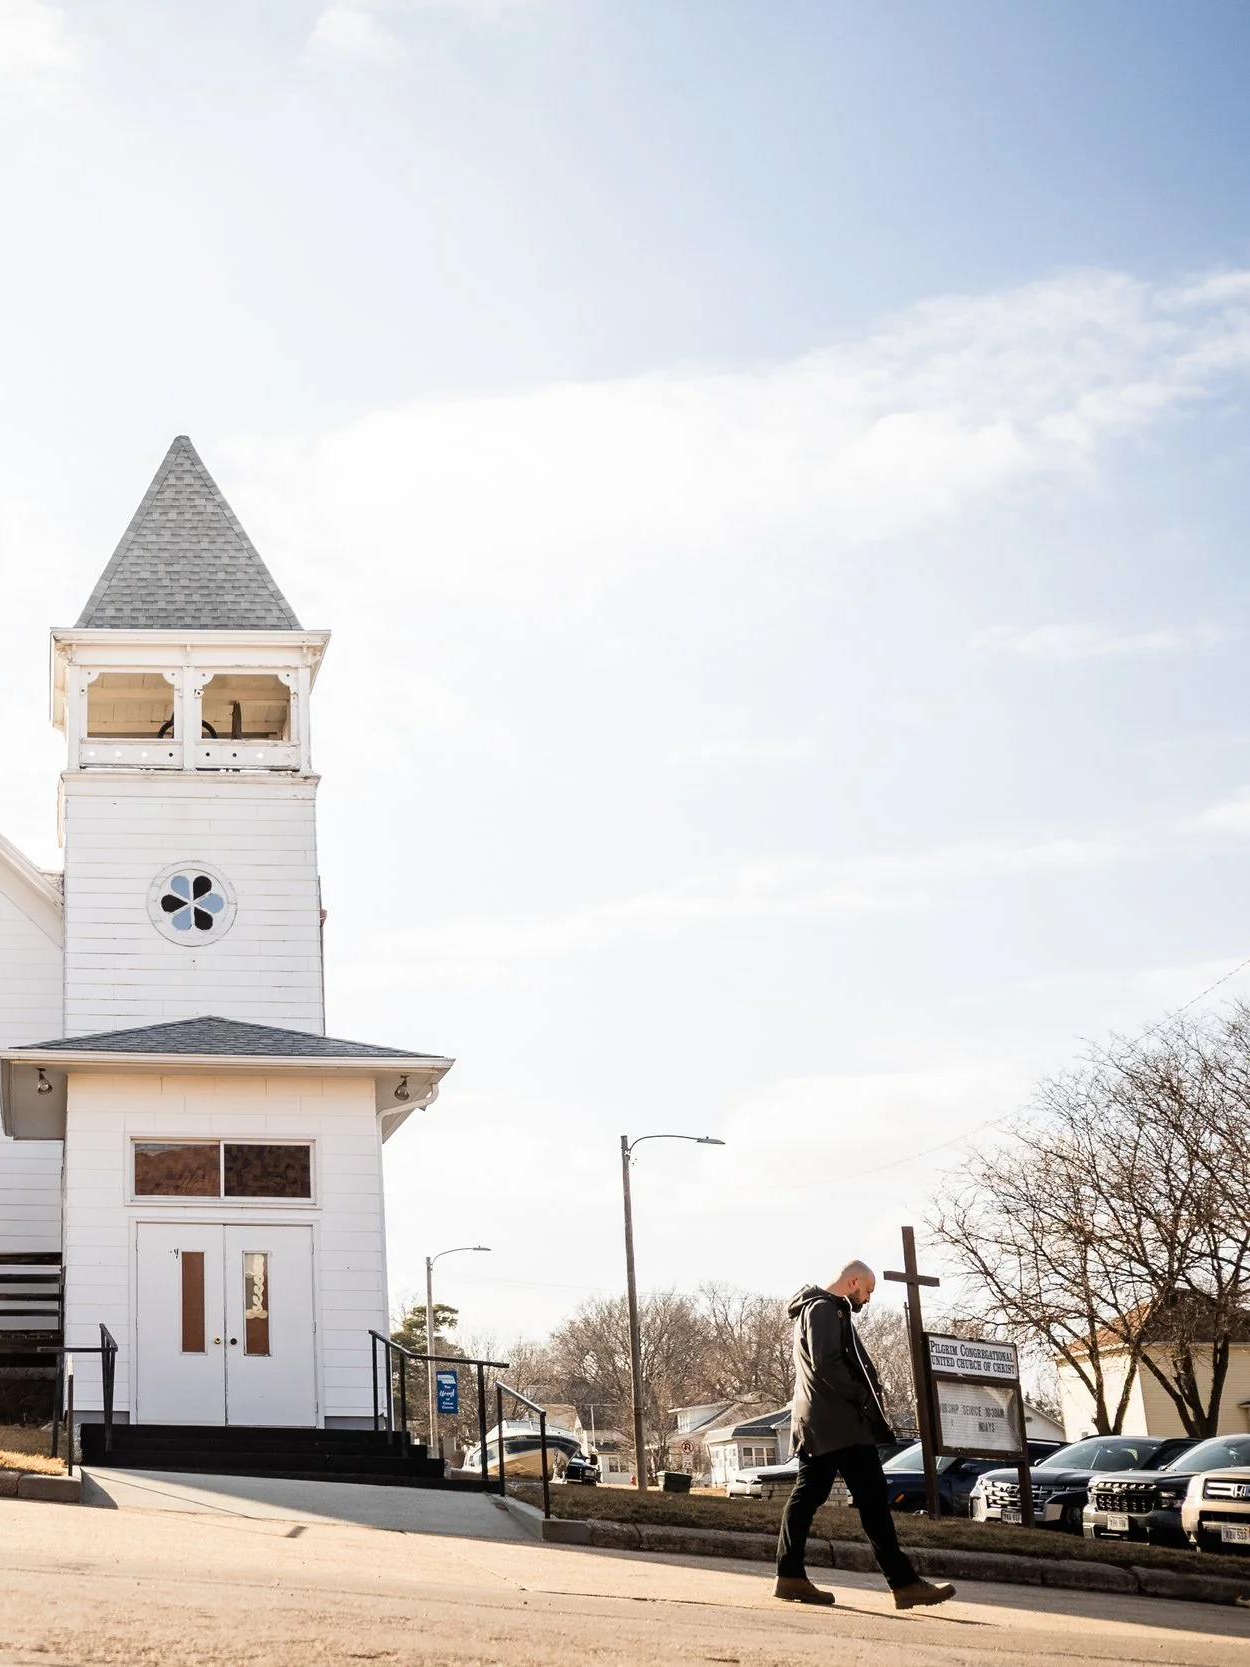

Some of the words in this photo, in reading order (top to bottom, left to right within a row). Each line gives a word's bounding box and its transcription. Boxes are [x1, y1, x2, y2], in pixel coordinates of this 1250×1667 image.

[930, 1341, 958, 1356] PILGRIM
[960, 1344, 1014, 1362] CONGREGATIONAL
[931, 1355, 955, 1367] UNITED
[956, 1358, 982, 1371] CHURCH
[983, 1361, 992, 1372] OF
[993, 1362, 1015, 1375] CHRIST
